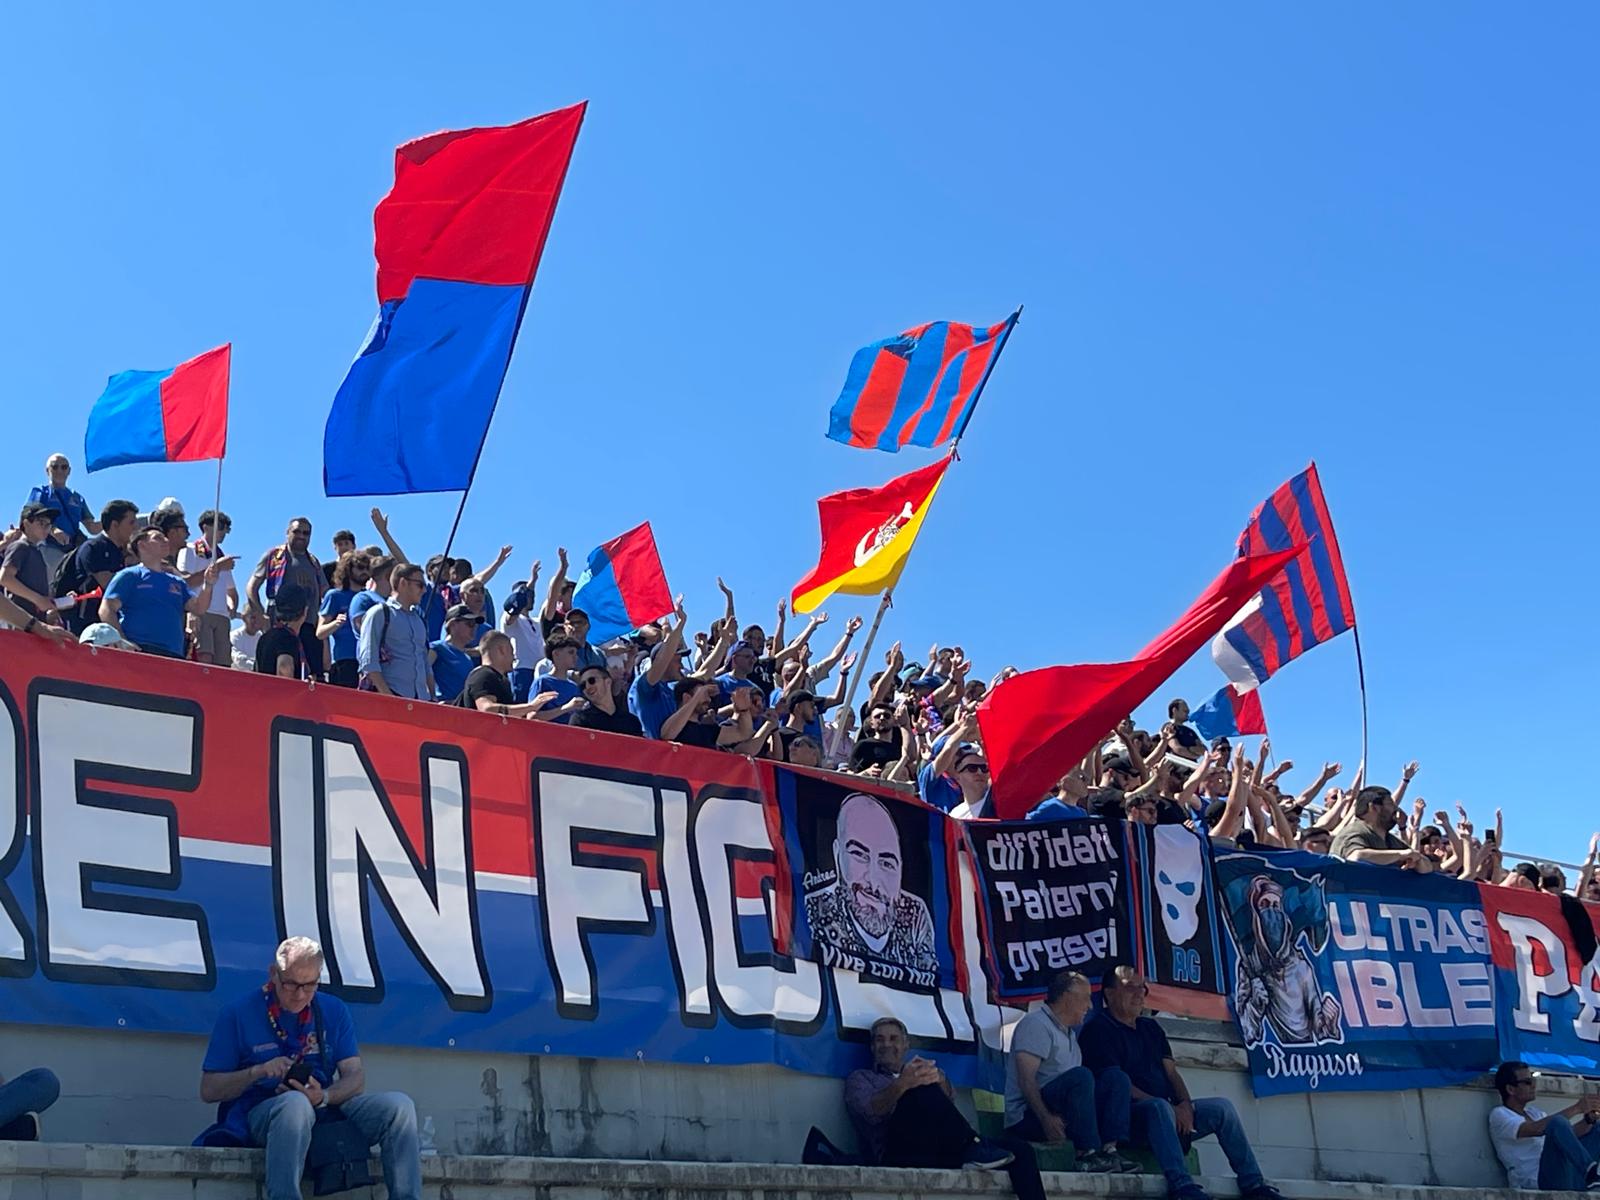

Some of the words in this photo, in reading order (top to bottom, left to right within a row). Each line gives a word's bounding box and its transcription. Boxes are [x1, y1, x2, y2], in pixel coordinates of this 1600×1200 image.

[275, 721, 490, 1004] IN
[987, 824, 1119, 871] diffidati
[802, 868, 837, 890] Andrea
[1329, 901, 1492, 954] ULTRAS
[869, 960, 904, 982] con
[1172, 946, 1201, 984] RG
[1263, 1042, 1363, 1089] Ragusa
